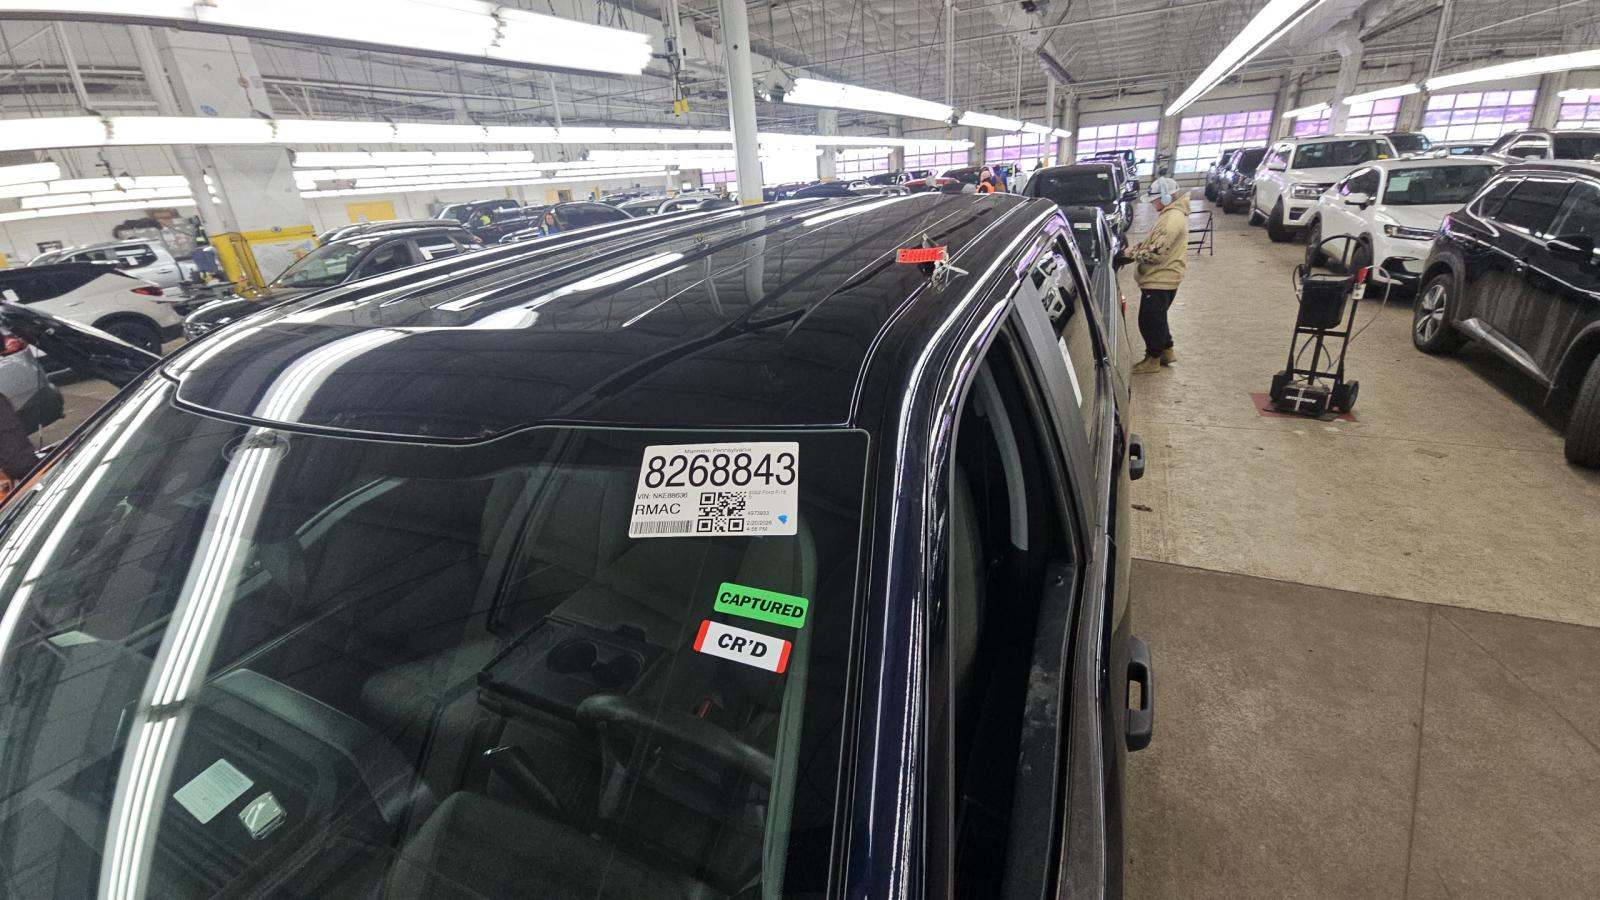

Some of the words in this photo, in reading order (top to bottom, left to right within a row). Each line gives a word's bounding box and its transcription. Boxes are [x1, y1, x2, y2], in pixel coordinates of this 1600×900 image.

[645, 453, 796, 488] 8268843
[635, 503, 681, 515] RMAC
[720, 592, 804, 618] CAPTURED
[718, 634, 767, 658] CR'D
